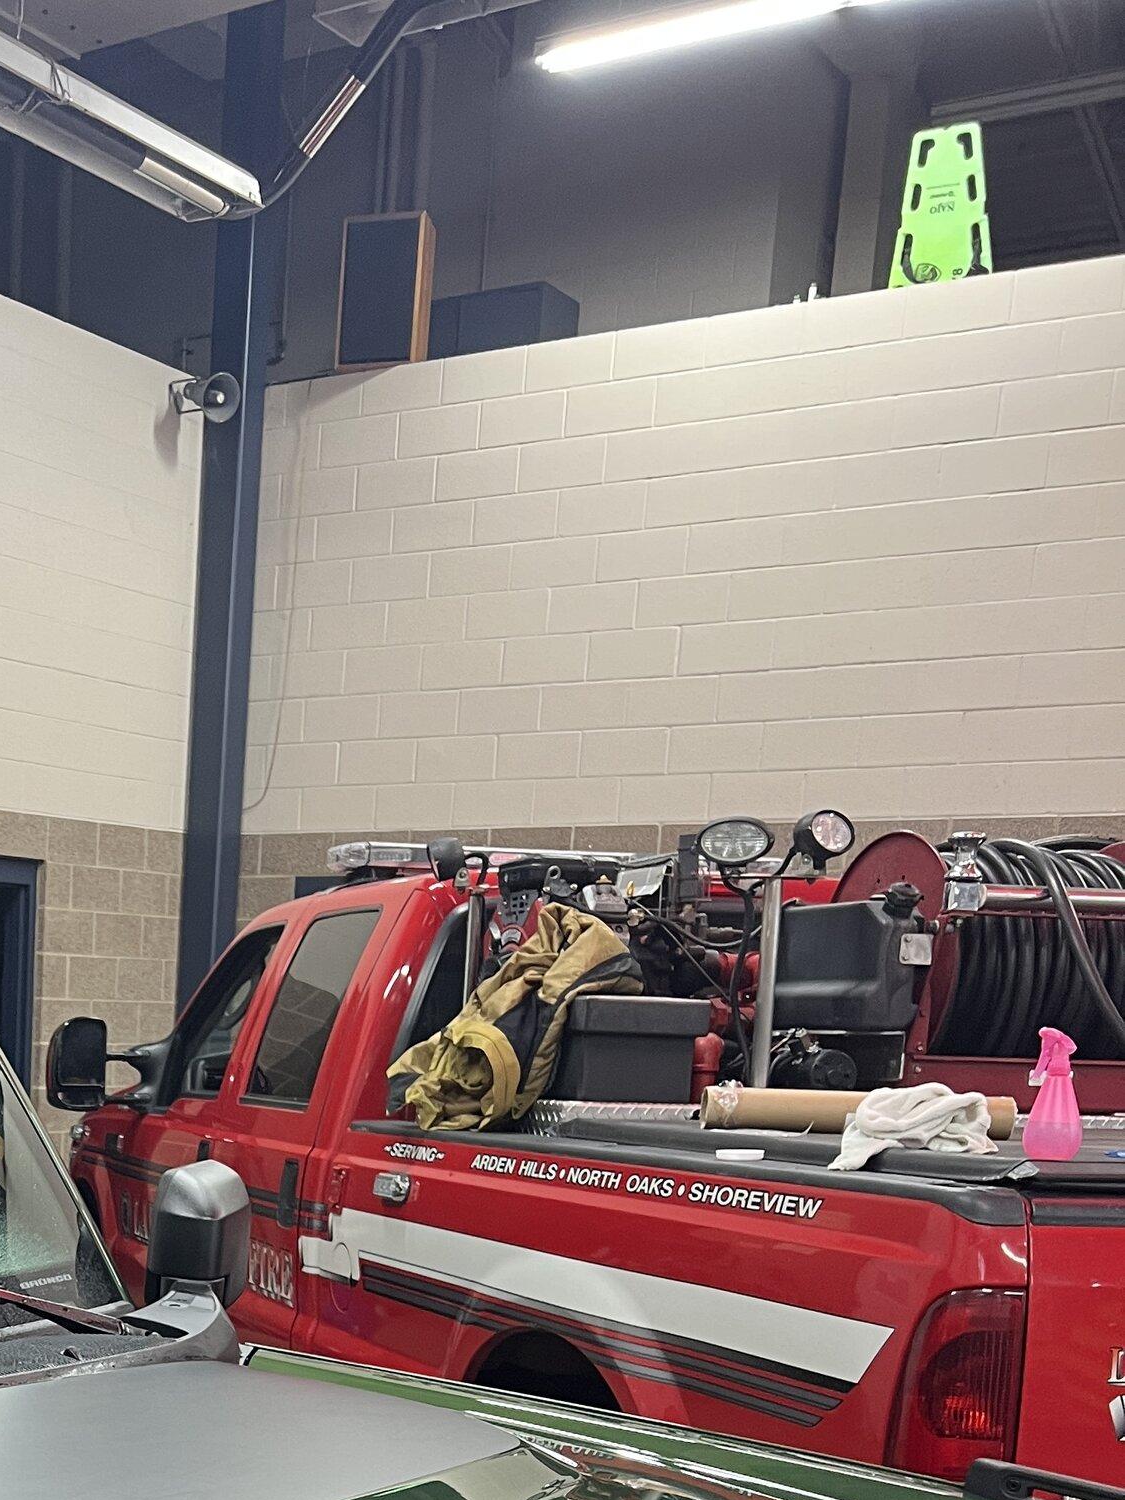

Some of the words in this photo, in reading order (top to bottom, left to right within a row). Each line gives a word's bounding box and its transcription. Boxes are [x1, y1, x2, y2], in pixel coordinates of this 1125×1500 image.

[471, 1154, 516, 1174] ARDEN
[518, 1160, 558, 1181] HILLS
[566, 1166, 622, 1190] NORTH
[626, 1174, 675, 1197] OAKS
[688, 1182, 823, 1219] SHOREVIEW
